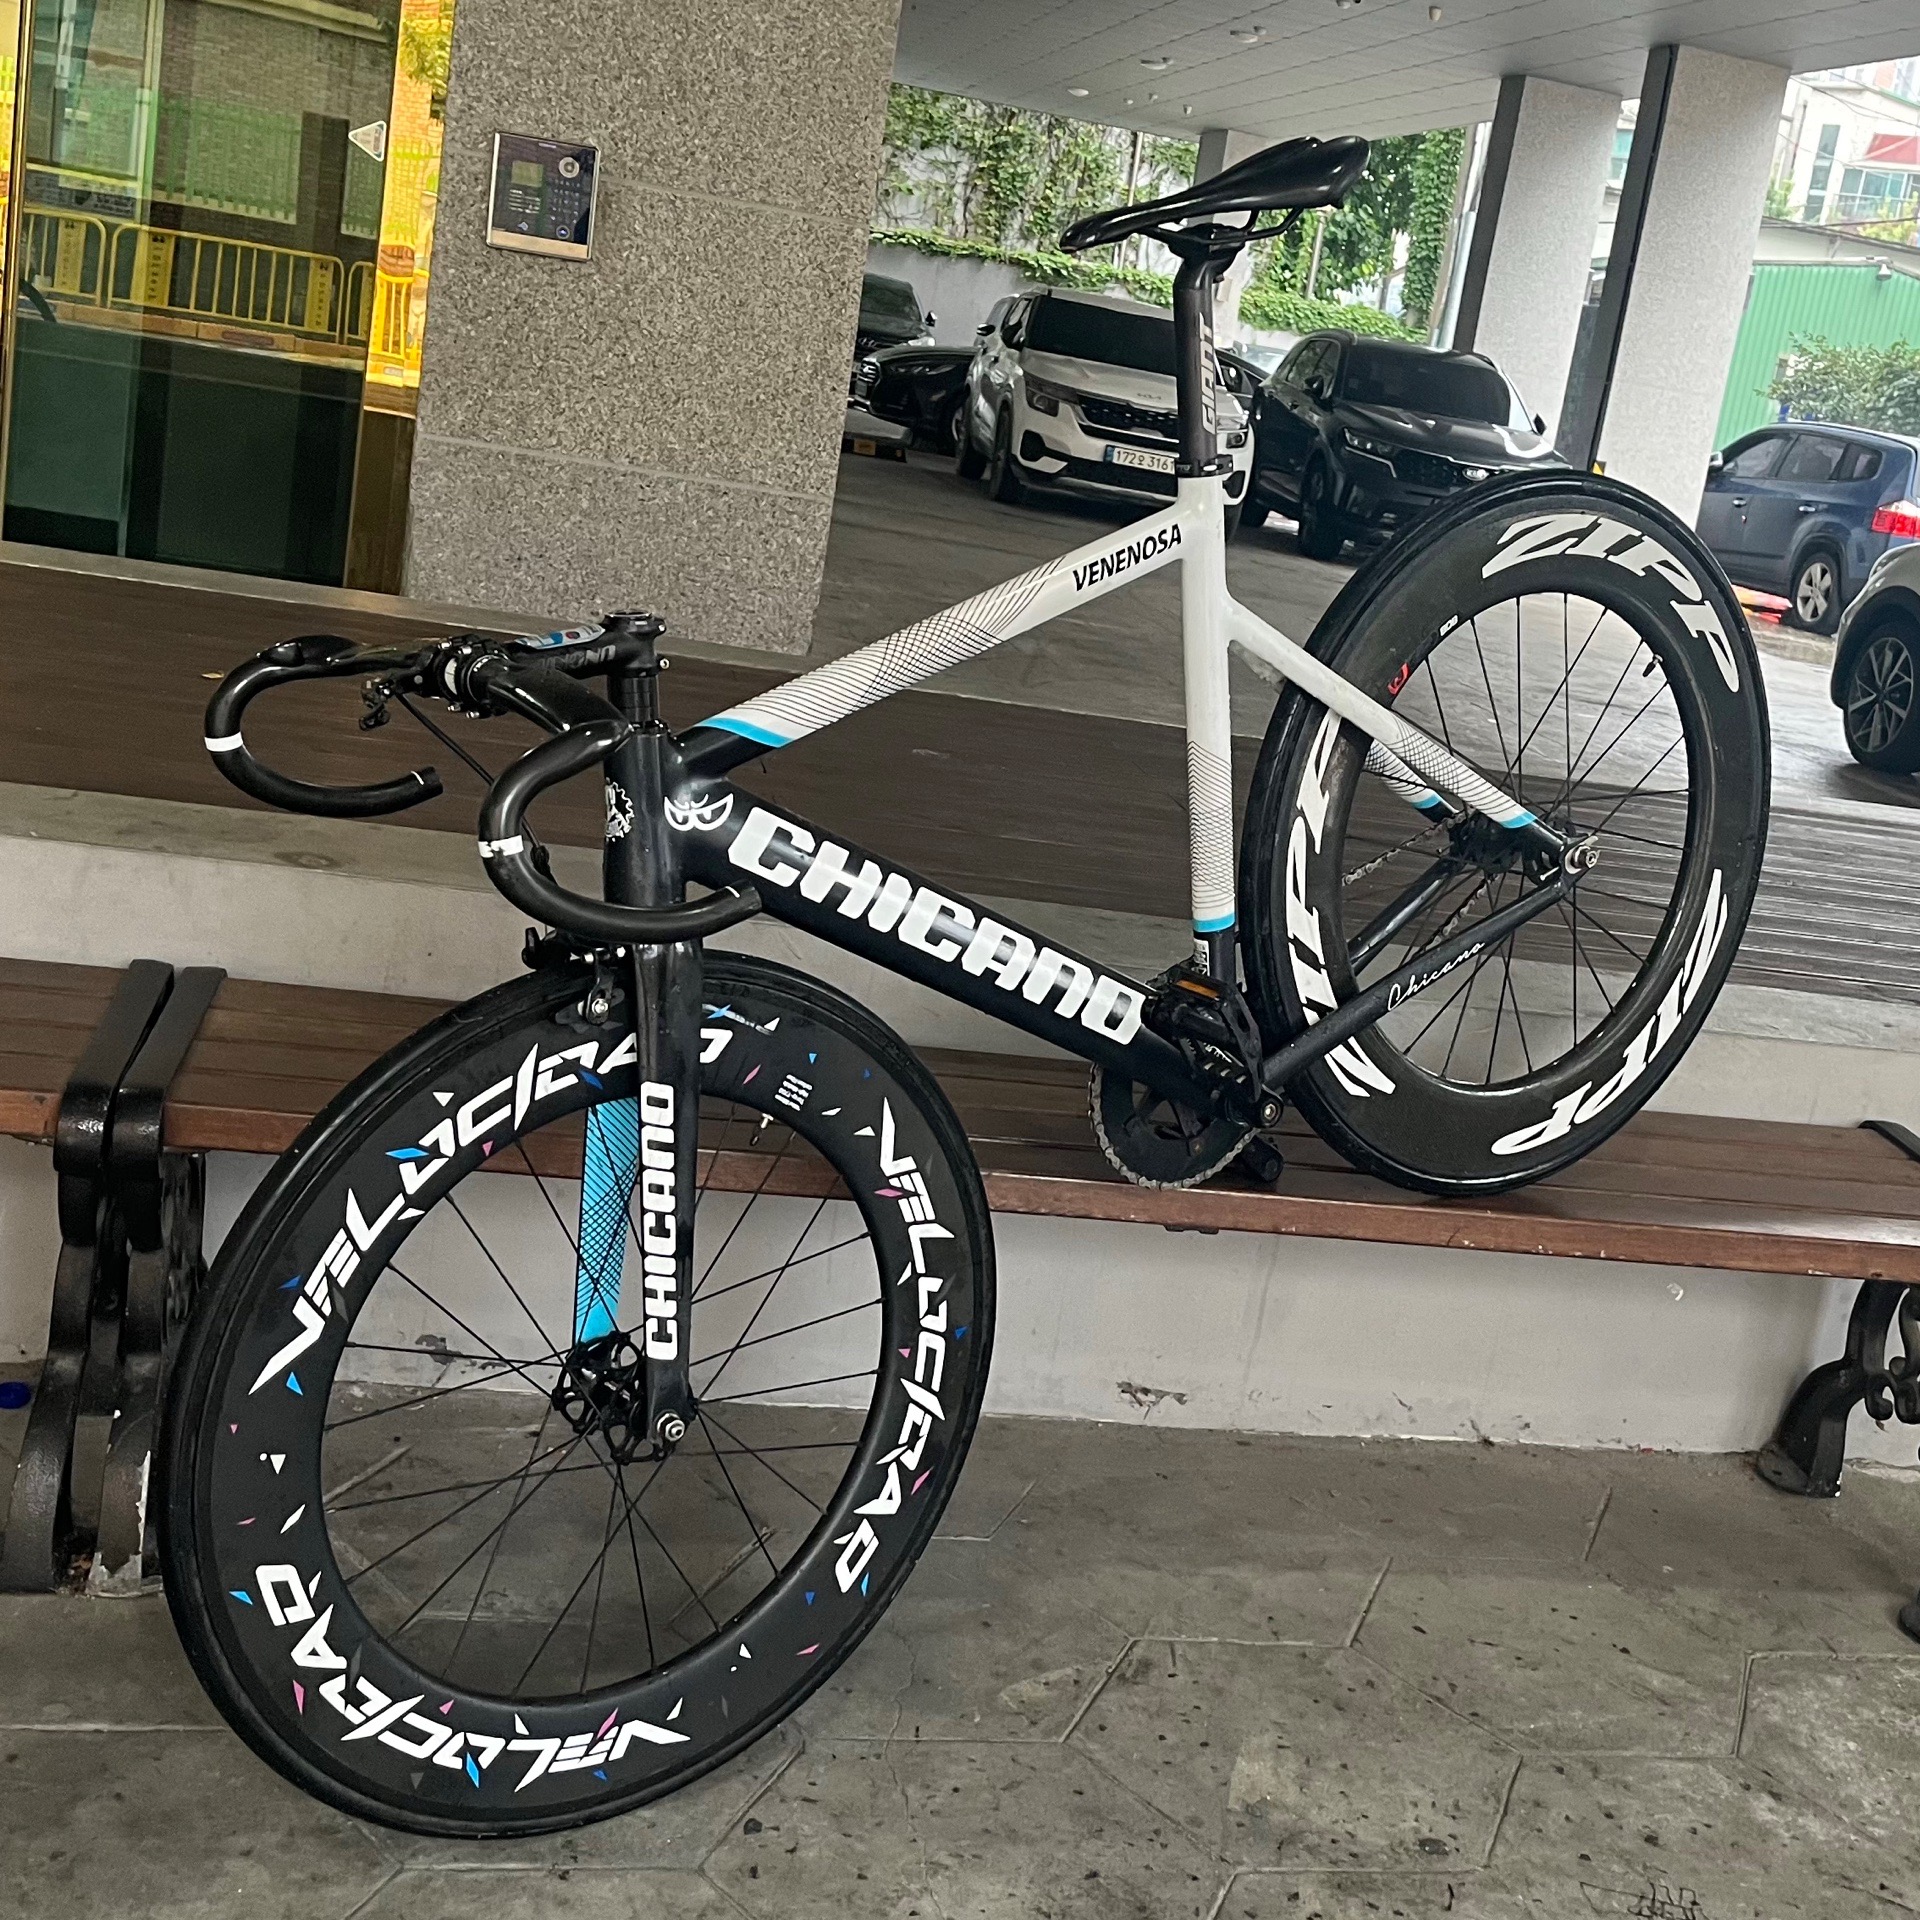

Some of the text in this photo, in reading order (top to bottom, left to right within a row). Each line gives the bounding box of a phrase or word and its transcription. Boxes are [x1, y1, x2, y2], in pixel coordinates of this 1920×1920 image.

[1116, 450, 1145, 465] 172오
[1072, 523, 1182, 592] VENENOSA
[1482, 513, 1740, 693] ZIPP
[728, 806, 1146, 1045] CHICANO
[1387, 942, 1486, 1012] Chicano
[1491, 868, 1728, 1155] ZIPP
[641, 1081, 678, 1361] CHICANO
